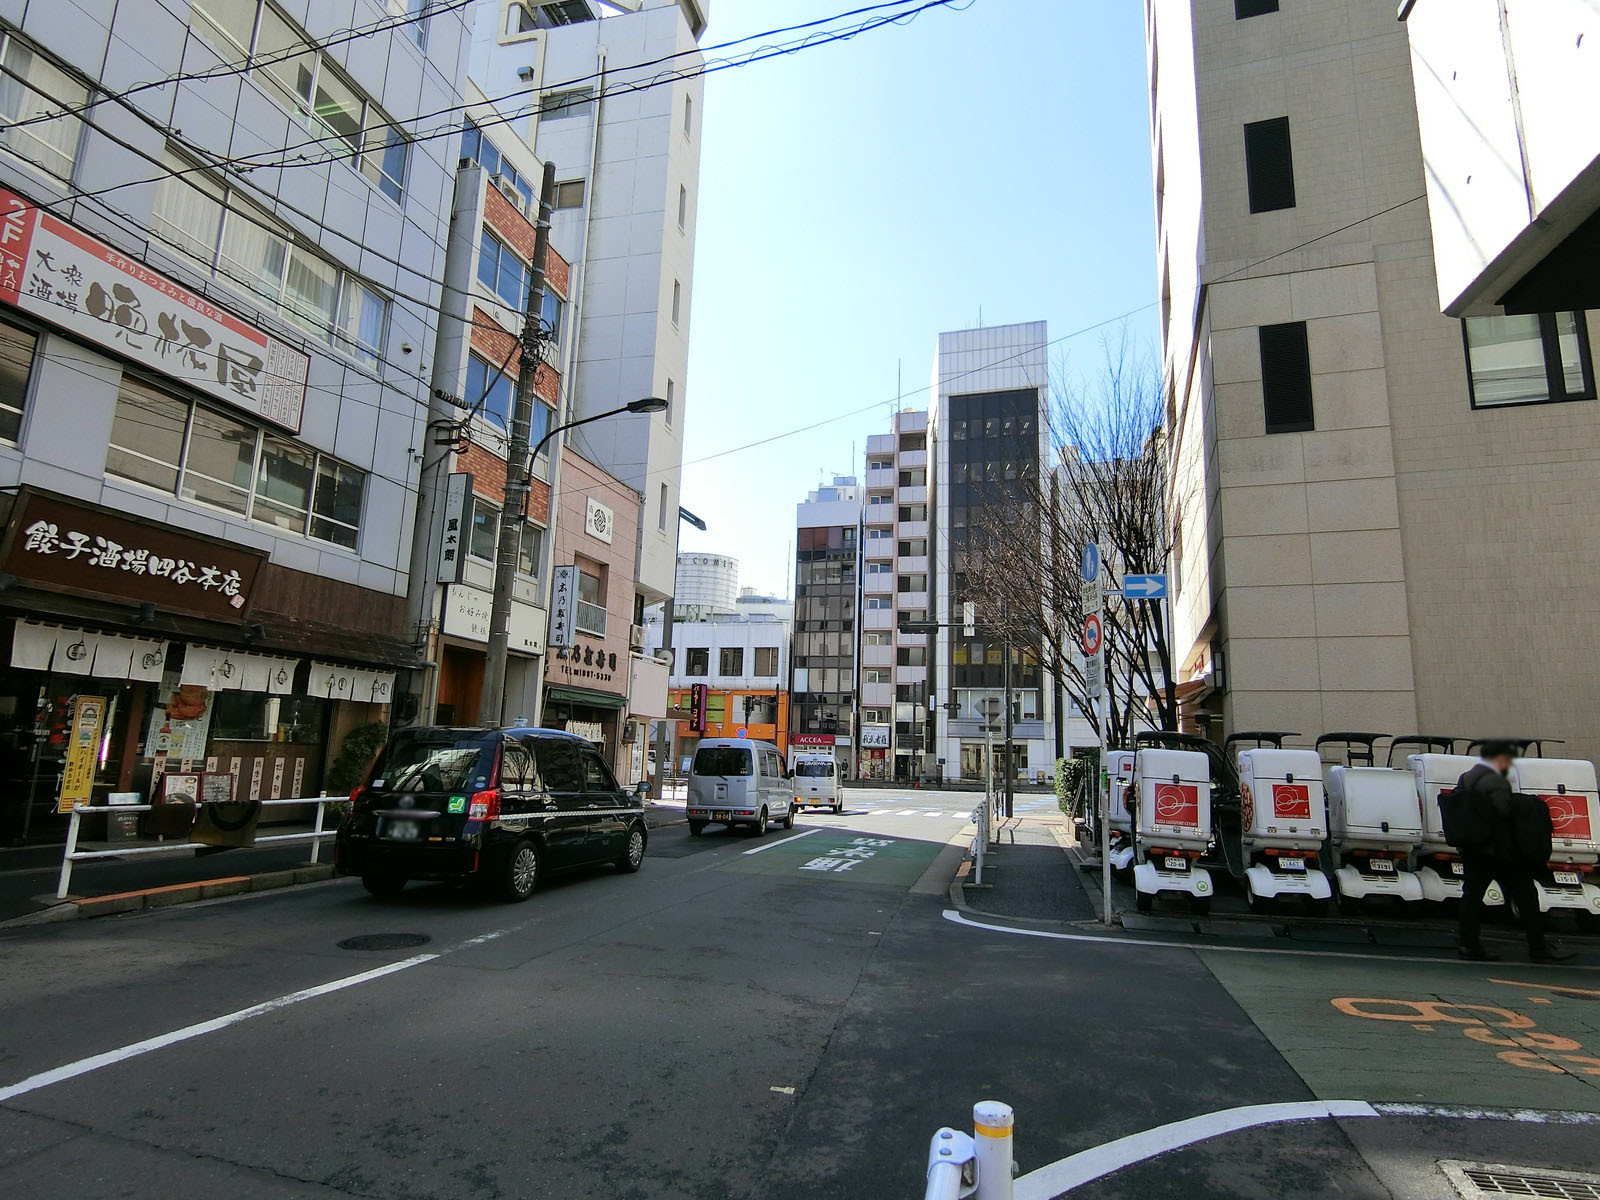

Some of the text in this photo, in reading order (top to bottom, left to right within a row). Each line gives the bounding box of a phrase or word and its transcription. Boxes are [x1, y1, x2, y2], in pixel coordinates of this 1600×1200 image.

[1, 198, 27, 244] 2F
[1, 269, 17, 293] 入口
[34, 249, 83, 287] 大衆
[28, 272, 79, 315] 酒場
[24, 520, 241, 596] 餃子酒場四谷本店
[692, 556, 734, 569] COMET
